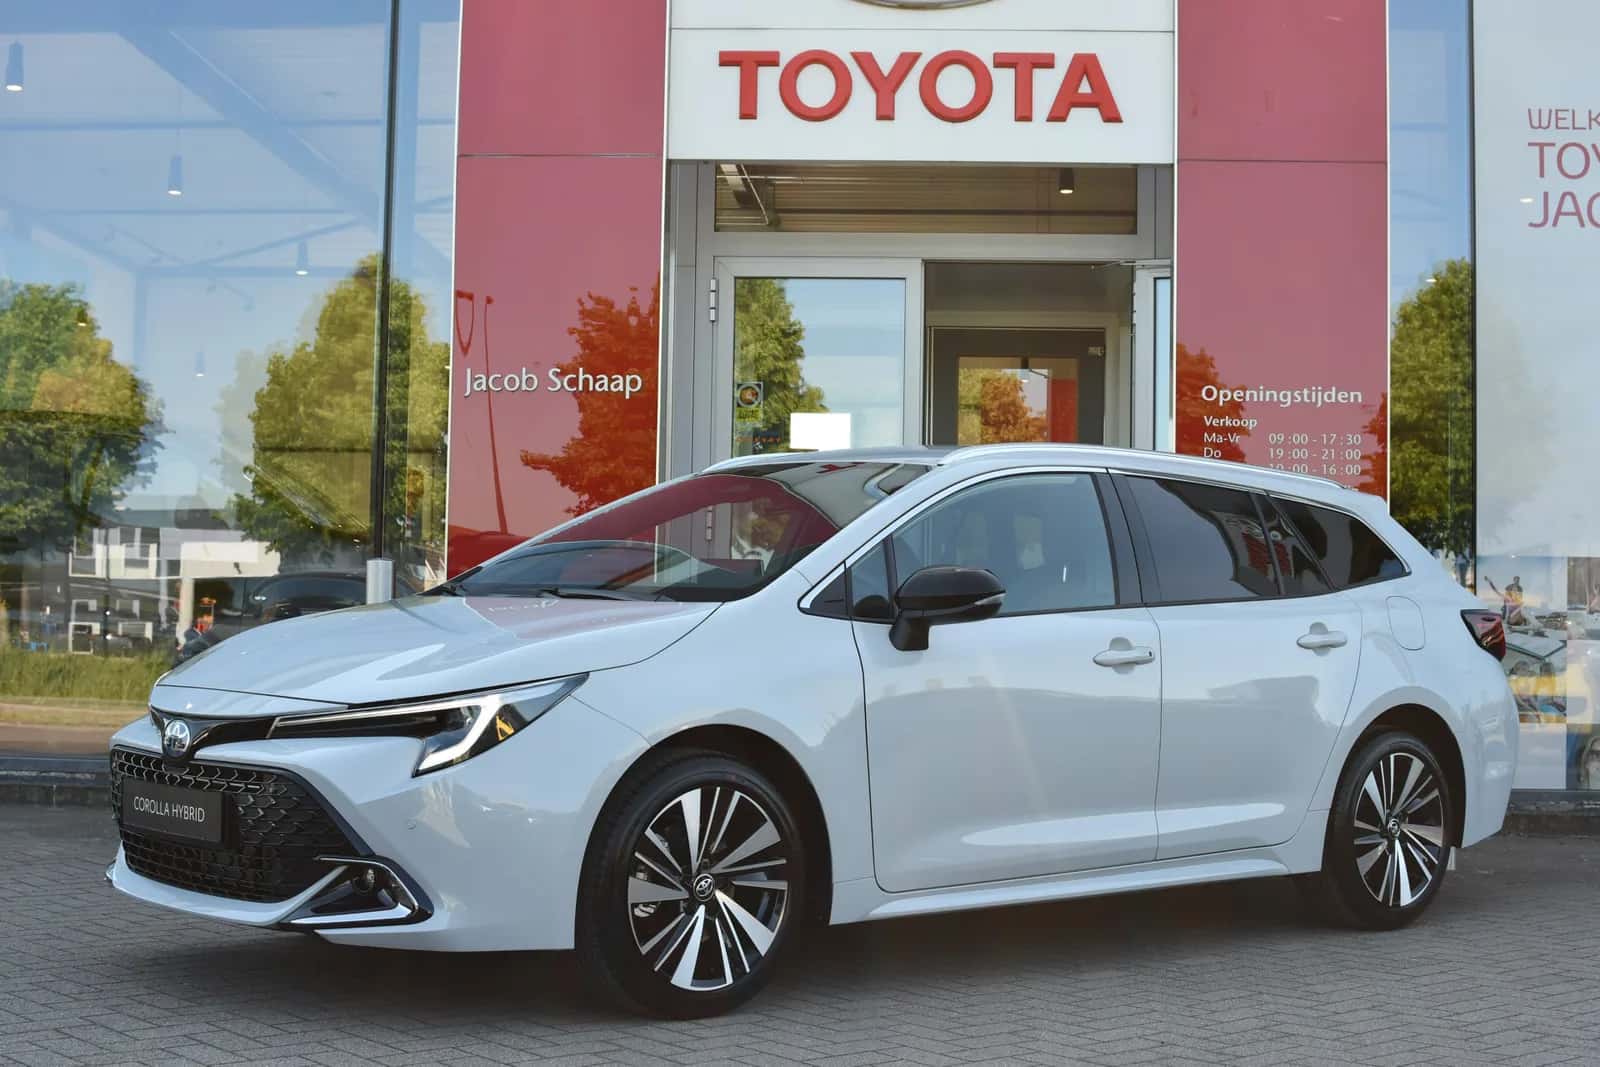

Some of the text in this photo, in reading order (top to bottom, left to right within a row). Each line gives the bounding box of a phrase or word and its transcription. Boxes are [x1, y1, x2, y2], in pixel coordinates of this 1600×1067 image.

[718, 49, 1124, 124] TOYOTA
[464, 367, 642, 399] Jacob Schaap
[1201, 385, 1362, 407] Openingstijden
[1203, 415, 1258, 430] Verkoop
[1204, 432, 1241, 444] Ma-Vr
[1204, 447, 1222, 458] Do
[133, 796, 205, 822] COROLLA HYBRID
